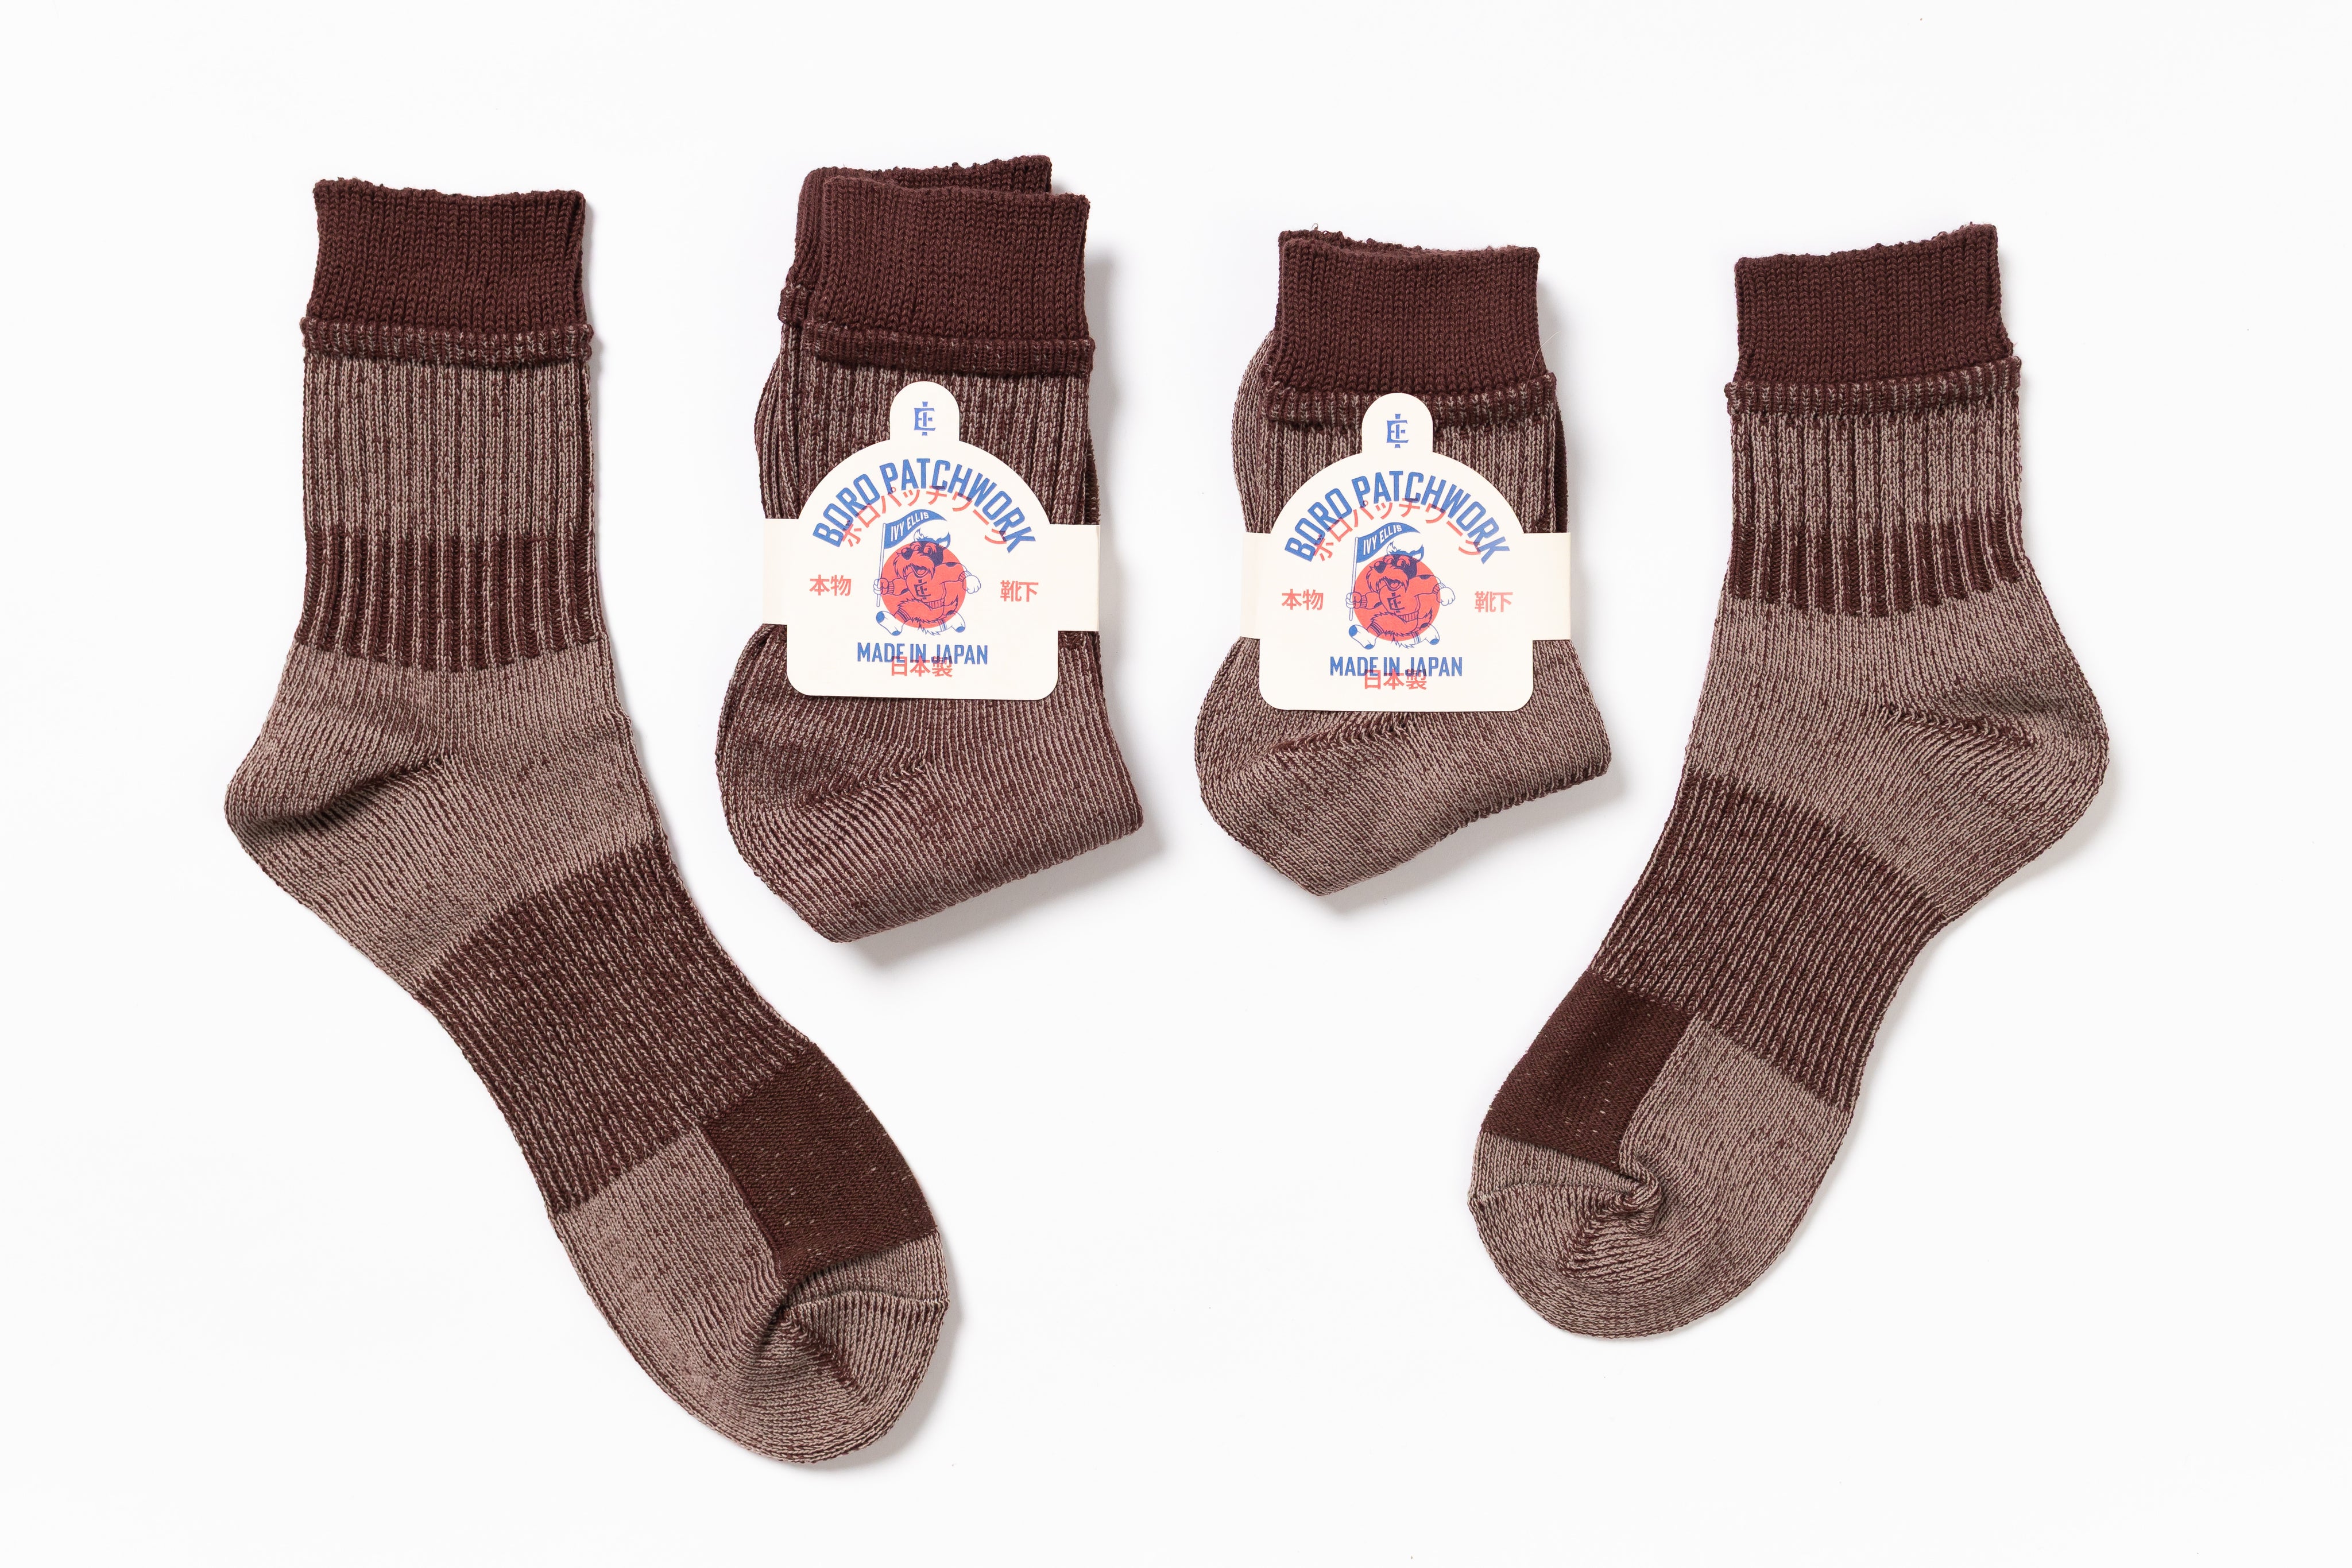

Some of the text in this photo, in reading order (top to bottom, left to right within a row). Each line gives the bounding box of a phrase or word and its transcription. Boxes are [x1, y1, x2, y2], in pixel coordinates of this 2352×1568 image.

[813, 458, 1036, 553] BORO PATCHWORK
[842, 485, 1007, 547] ボロパッチワーク
[891, 512, 929, 541] IVY ELLIS
[1285, 471, 1510, 564] BORO PATCHWORK
[1313, 498, 1481, 562] ボロパッチワーク
[1363, 525, 1402, 555] IVY ELLIS
[809, 575, 852, 597] 本物
[1000, 580, 1039, 602] 靴下
[1282, 589, 1324, 611] 本物
[1474, 591, 1513, 613] 靴下
[857, 642, 988, 665] MADE IN JAPAN
[891, 656, 953, 677] 日本製
[1330, 656, 1463, 677] MADE IN JAPAN
[1364, 668, 1427, 690] 日本製
